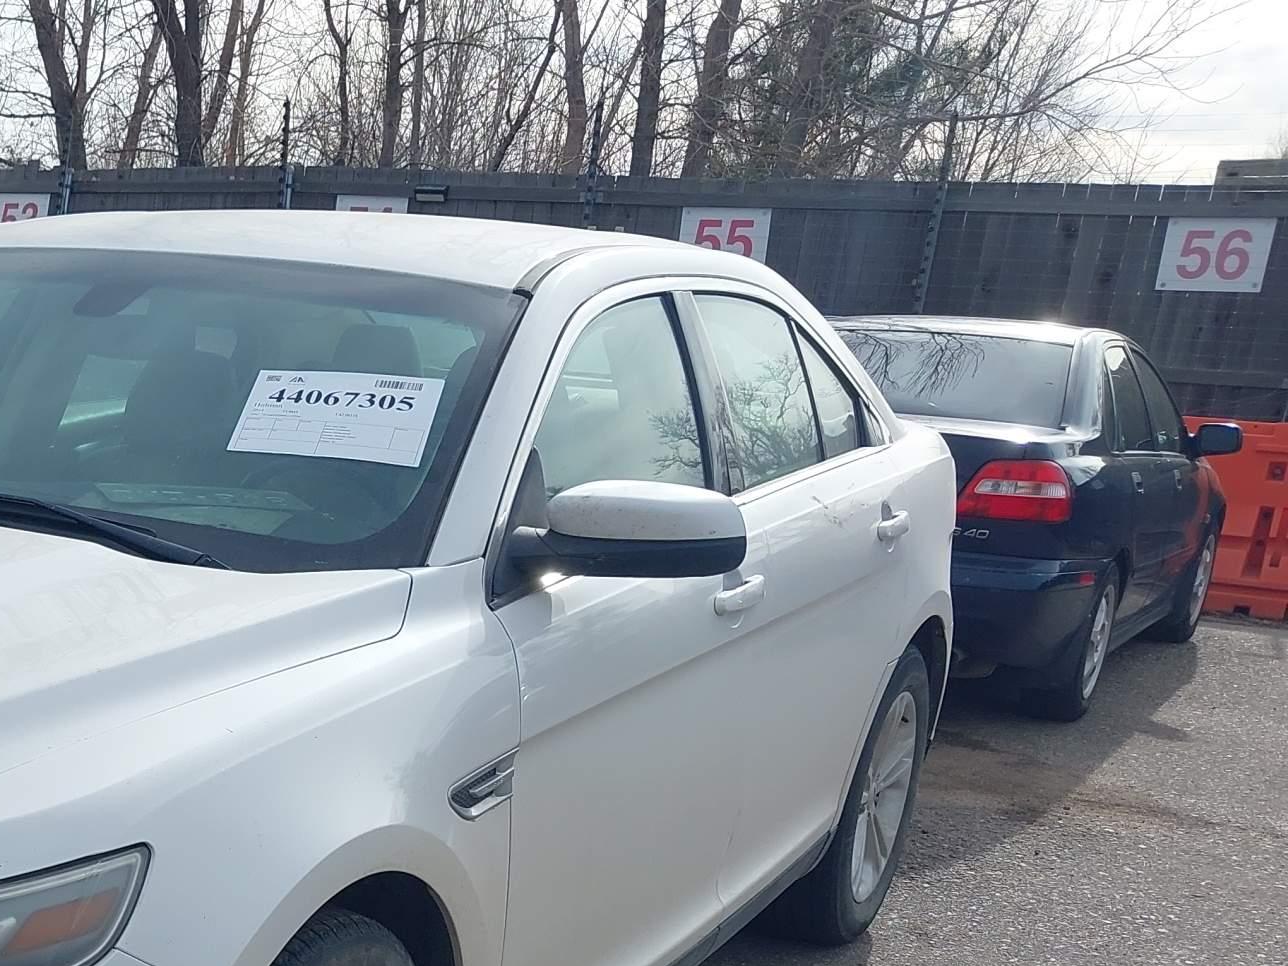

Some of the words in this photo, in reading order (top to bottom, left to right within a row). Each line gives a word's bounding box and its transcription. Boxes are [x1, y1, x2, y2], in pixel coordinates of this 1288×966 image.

[695, 219, 754, 257] 55
[1176, 229, 1253, 280] 56
[268, 388, 416, 411] 44067305
